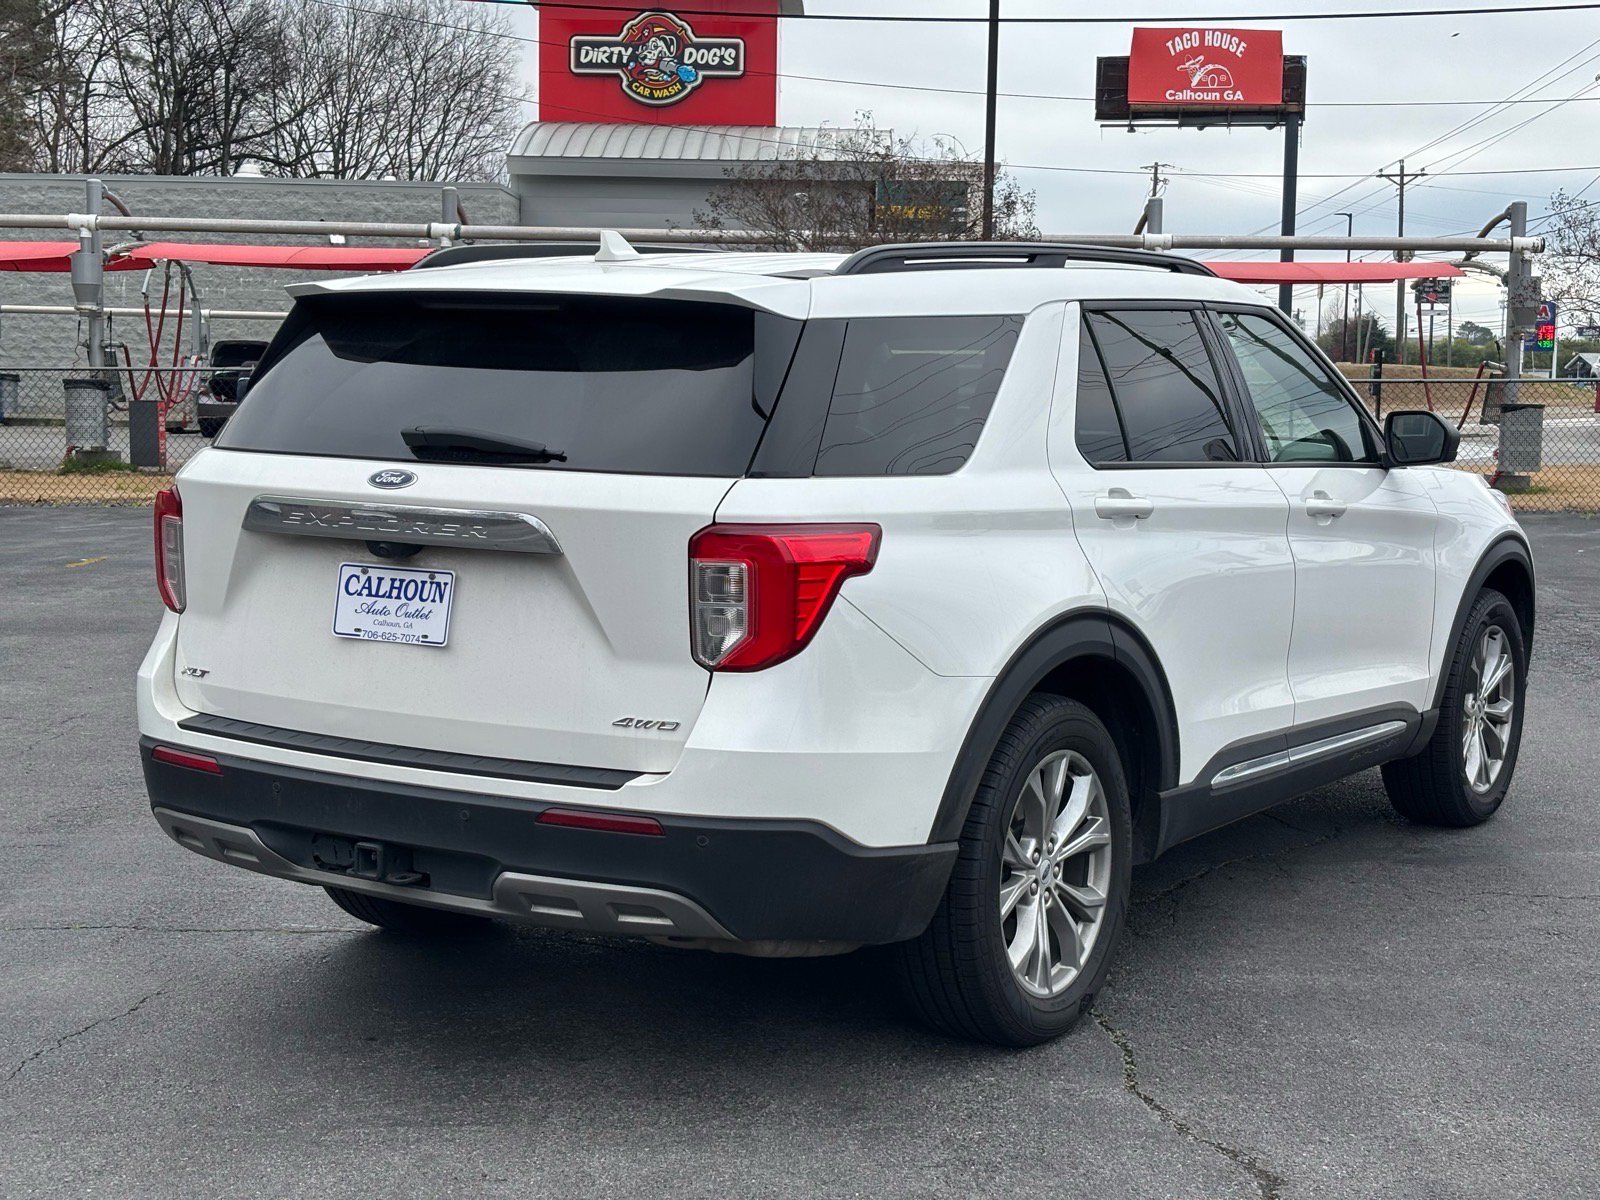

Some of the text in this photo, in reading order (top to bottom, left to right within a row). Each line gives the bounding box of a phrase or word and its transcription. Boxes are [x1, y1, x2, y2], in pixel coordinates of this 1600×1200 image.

[1165, 30, 1247, 57] TACO HOUSE
[683, 46, 736, 66] DOG'S
[631, 82, 682, 99] CAR WASH
[1165, 89, 1244, 101] Calhoun GA
[375, 471, 406, 484] Ford
[282, 512, 488, 539] EXPLORER
[344, 573, 449, 604] CALHOUN
[354, 600, 433, 620] Auto Outlet
[362, 630, 421, 643] 706-625-7074
[181, 666, 210, 678] XLT
[611, 717, 682, 732] 4WD
